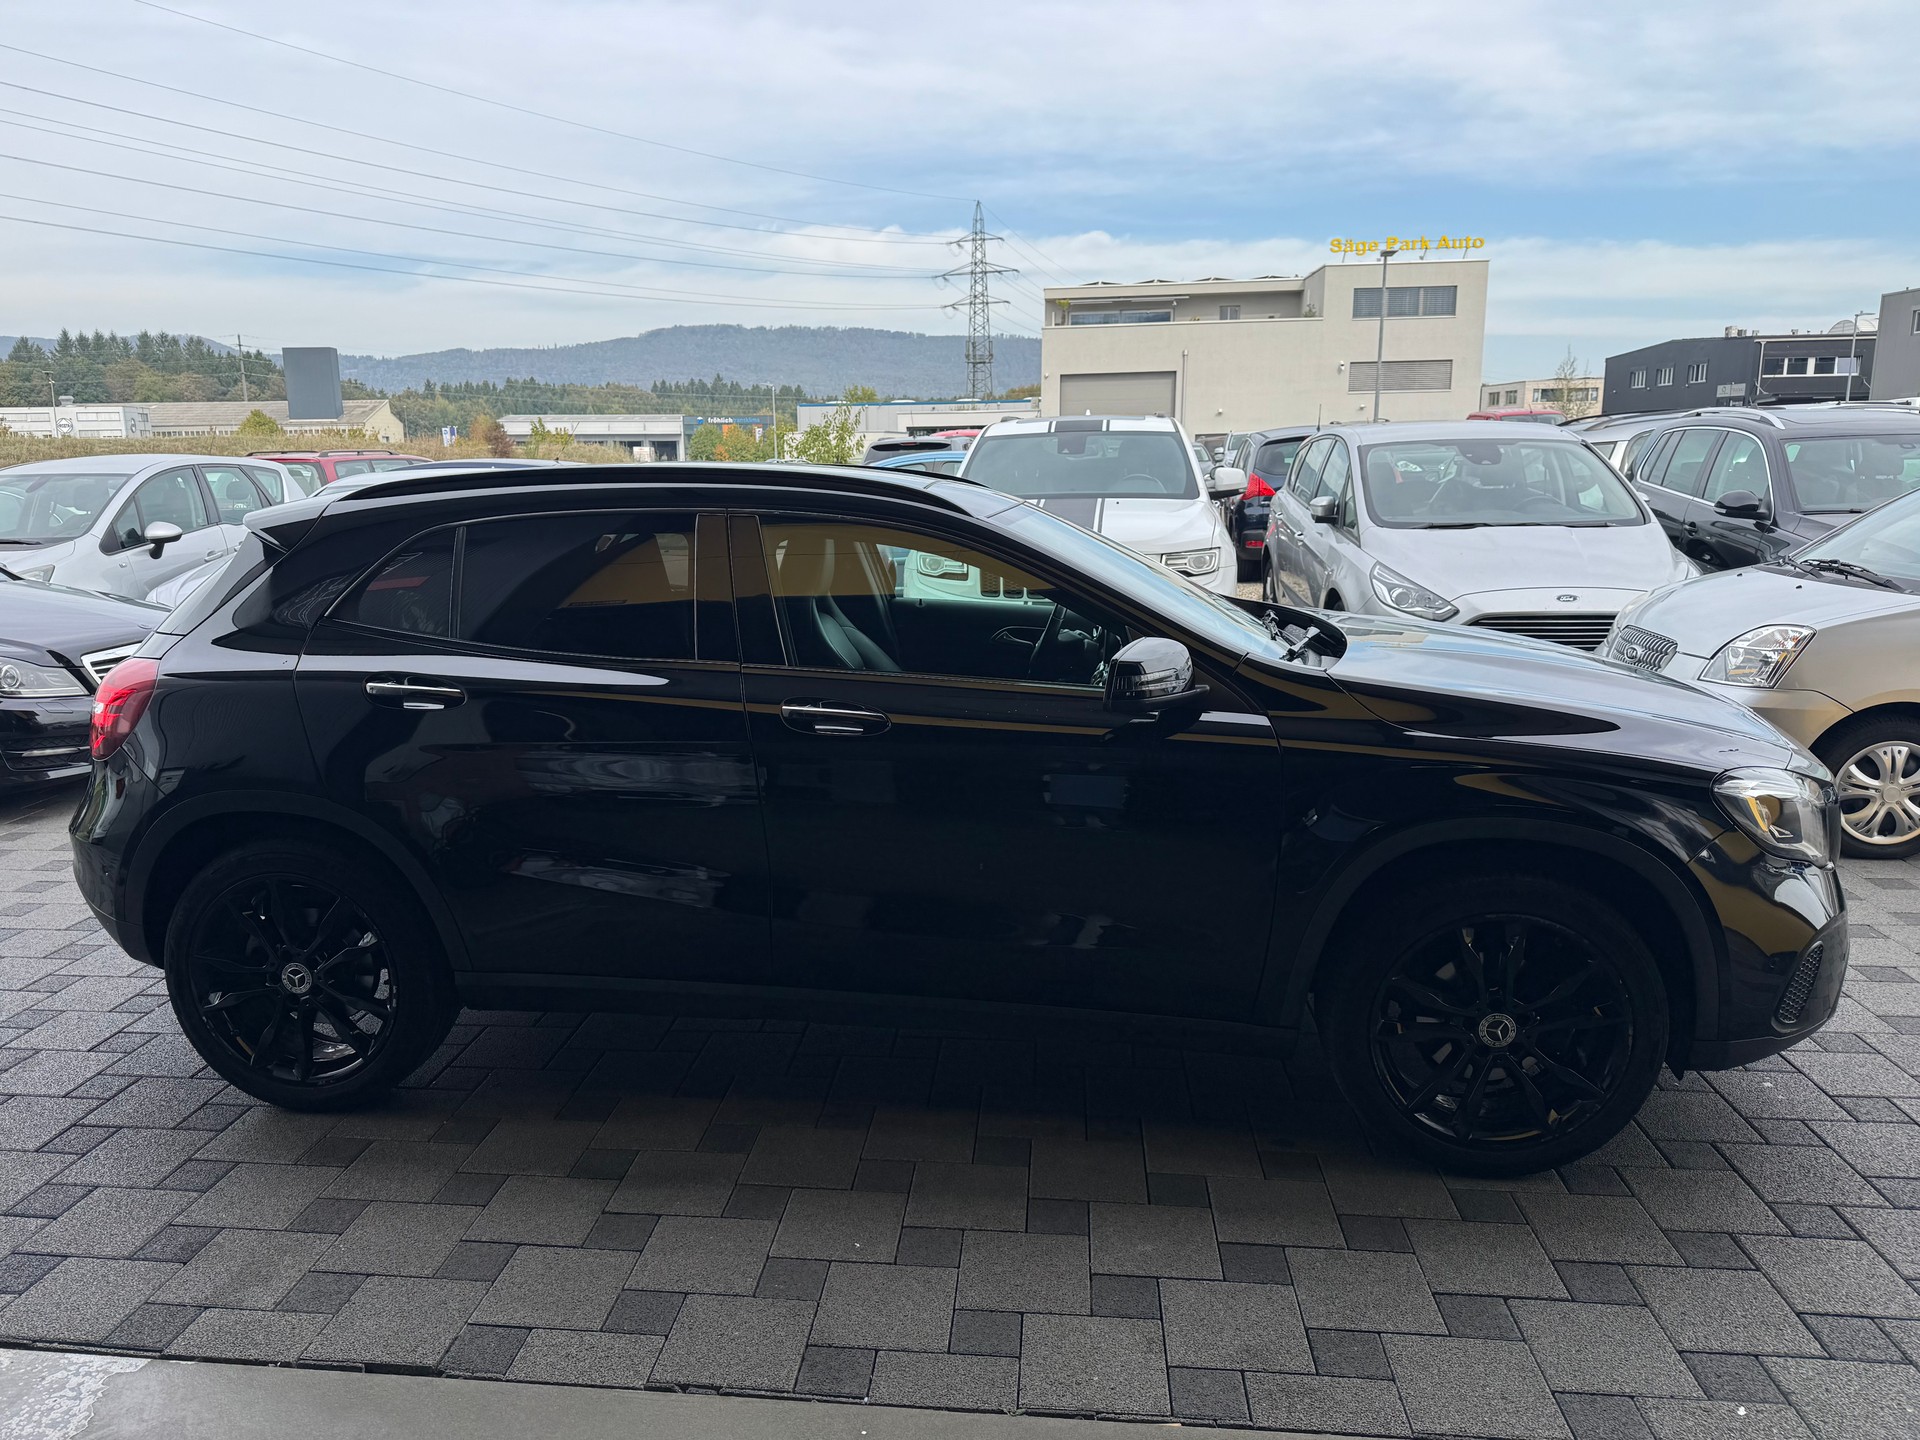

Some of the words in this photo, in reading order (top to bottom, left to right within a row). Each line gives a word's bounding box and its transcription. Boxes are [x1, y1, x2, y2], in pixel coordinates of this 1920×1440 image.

[1330, 238, 1379, 256] Säge
[1386, 235, 1430, 251] Park
[1437, 235, 1485, 250] Auto
